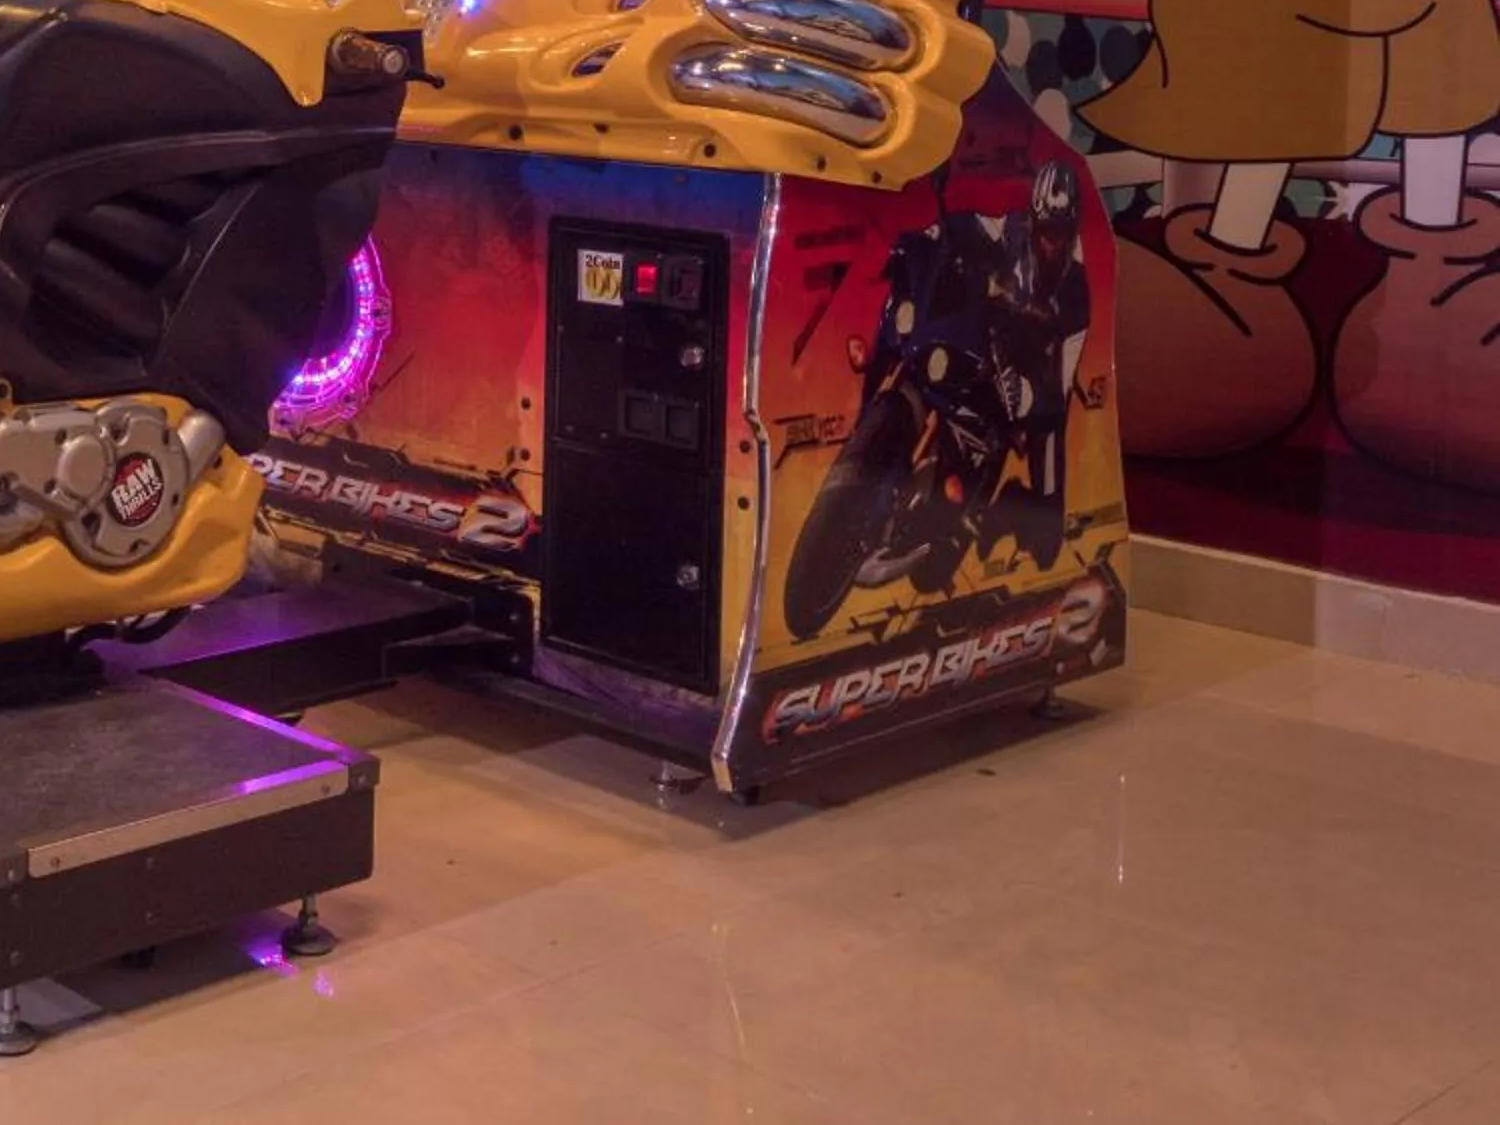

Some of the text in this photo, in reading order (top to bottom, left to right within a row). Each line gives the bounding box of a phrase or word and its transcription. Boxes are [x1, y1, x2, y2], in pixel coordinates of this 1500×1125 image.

[111, 458, 159, 512] RAW
[248, 451, 530, 552] PER BIKES 2
[771, 573, 1108, 730] SUPER BIKES 2
